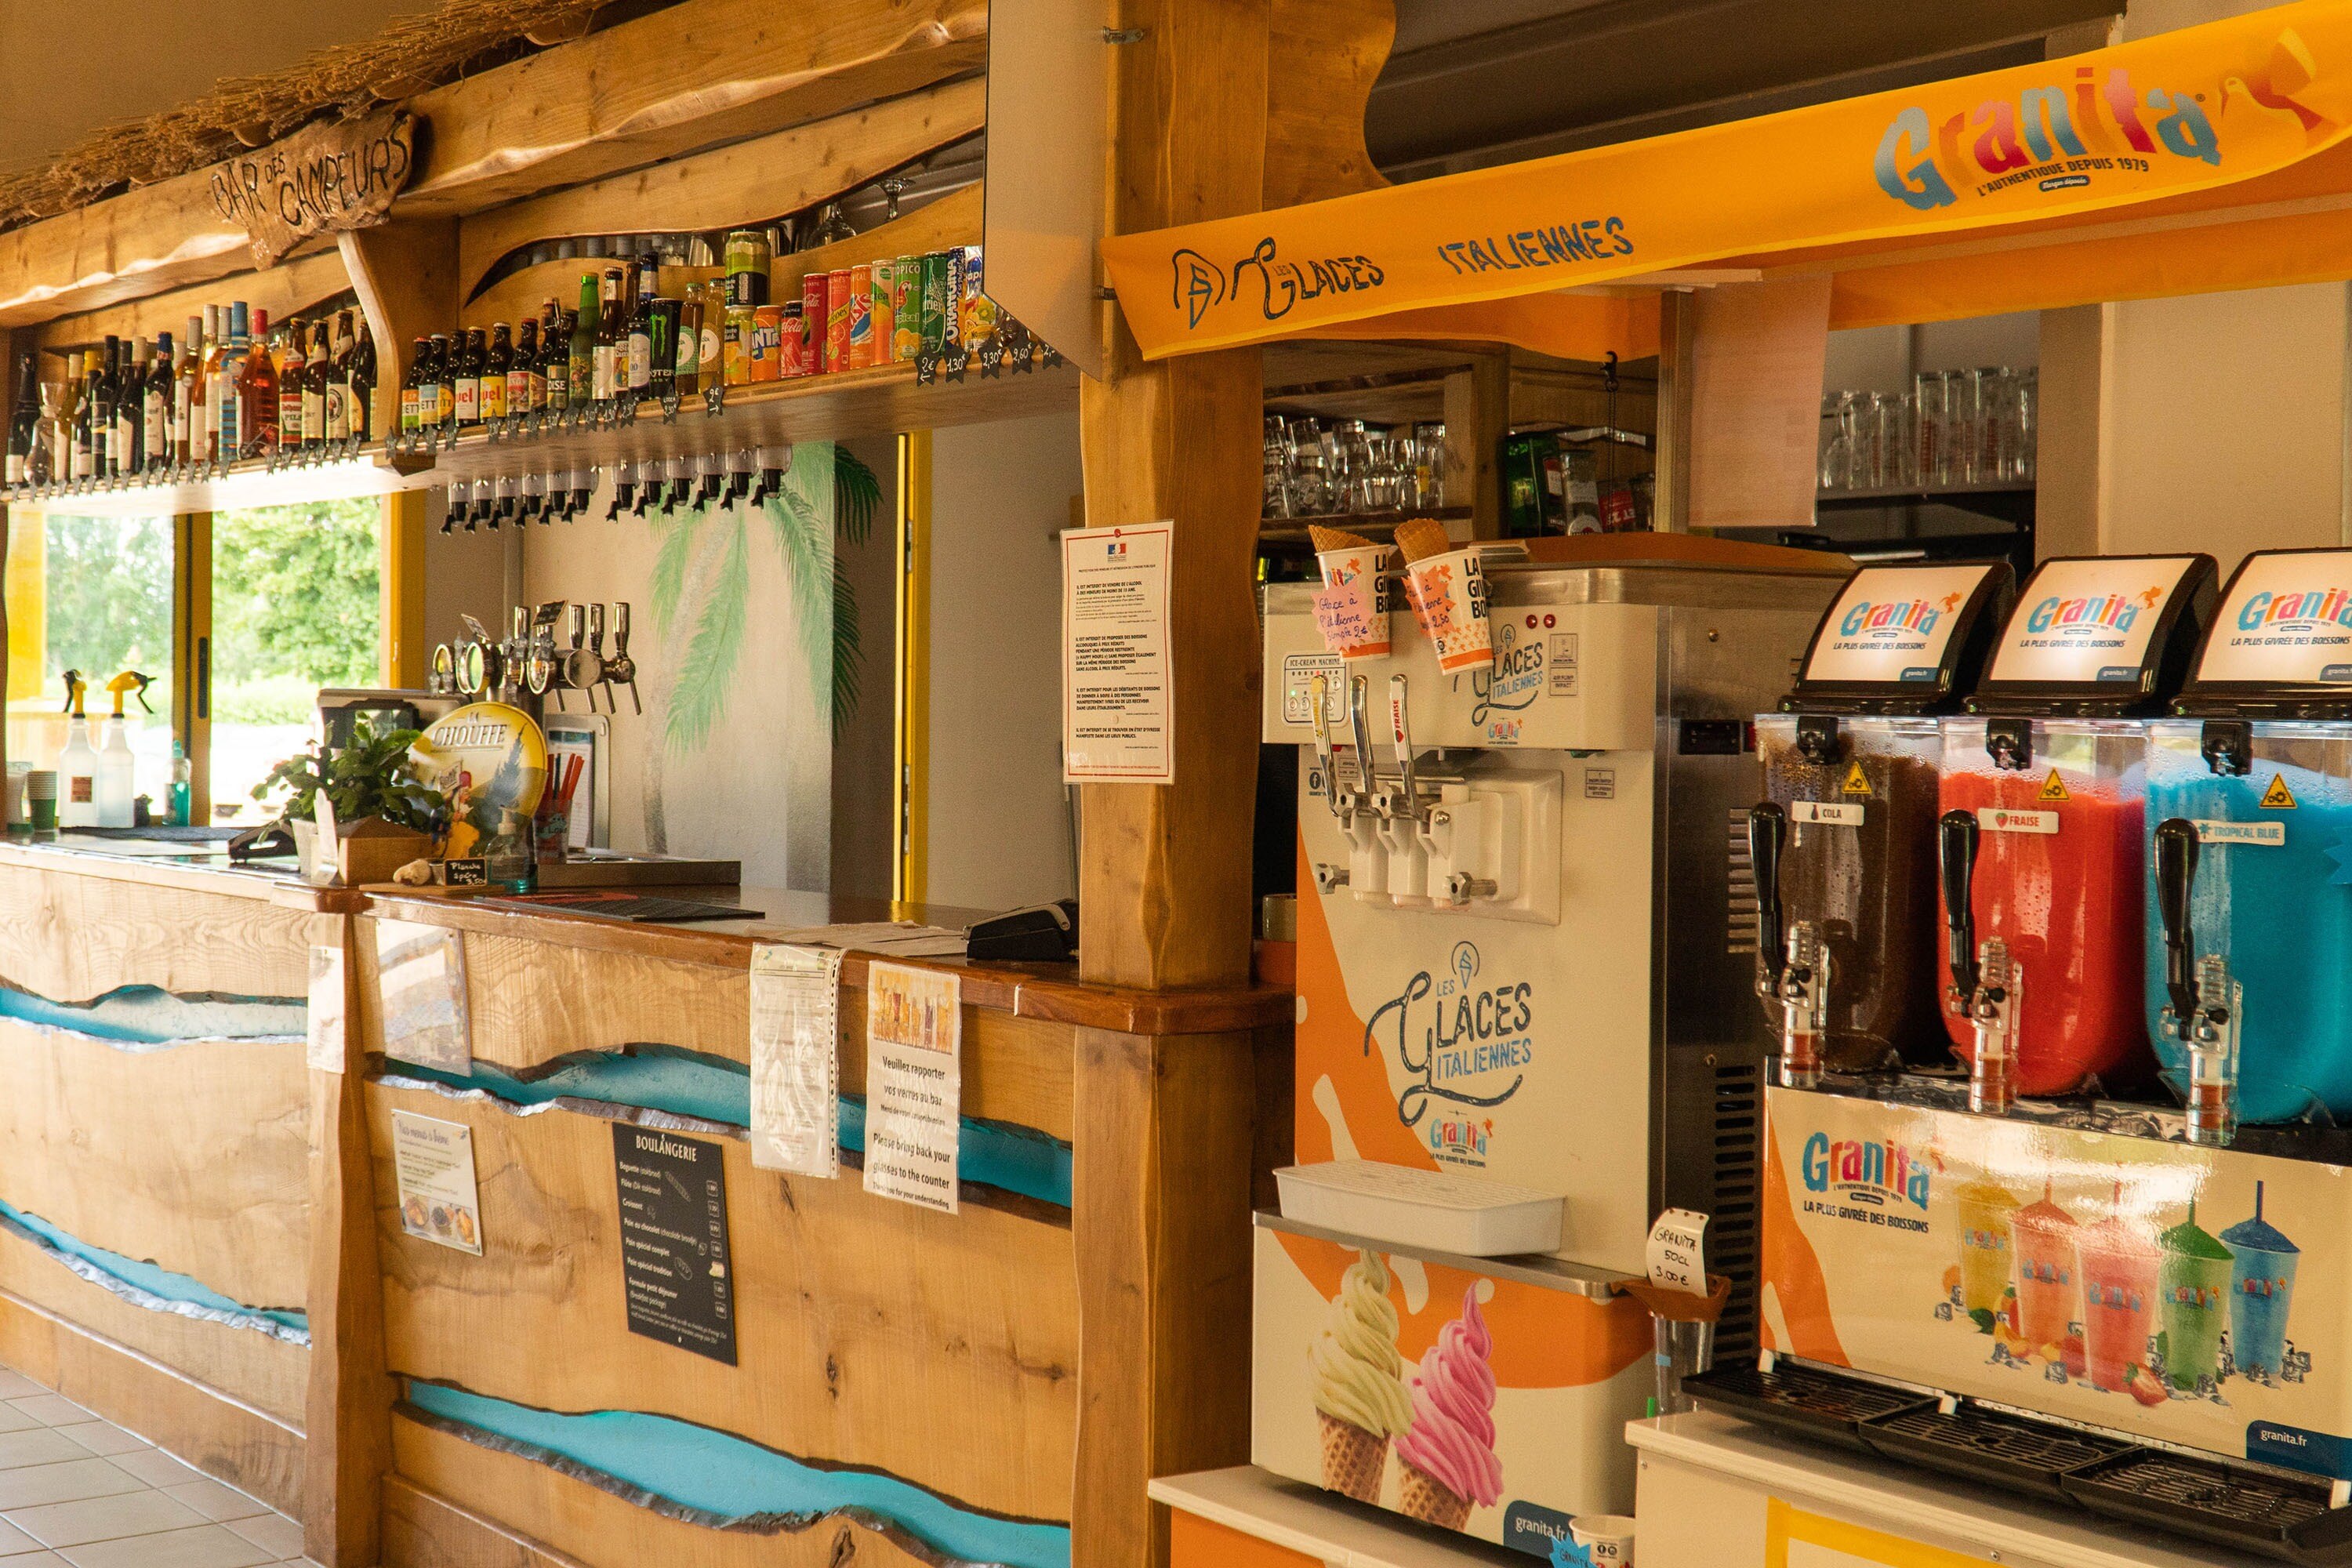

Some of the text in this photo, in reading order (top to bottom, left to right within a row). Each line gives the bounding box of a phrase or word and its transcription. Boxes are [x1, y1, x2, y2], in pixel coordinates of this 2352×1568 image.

[1875, 67, 2222, 211] Granita
[212, 132, 407, 226] BAR DES CAMPEURS
[1976, 157, 2150, 197] L'AUTHENTIQUE DEPUIS 1979
[895, 264, 920, 274] OPICO
[1235, 216, 1634, 320] GLACES ITALIENNES
[946, 258, 960, 340] ORANGINA
[753, 328, 781, 348] NTA
[1319, 593, 1358, 611] Glace à
[2027, 593, 2139, 633] Granita
[1840, 599, 1940, 637] Granita
[2264, 636, 2293, 645] GIVRÉE
[2295, 637, 2310, 645] DES
[2311, 636, 2351, 644] BOISSONS
[1493, 670, 1544, 699] ITALIENNES
[1393, 699, 1402, 728] FRAISE
[432, 723, 508, 747] CHOUFFE
[1822, 808, 1842, 820] COLA
[2009, 815, 2040, 827] FRAISE
[2213, 826, 2280, 839] TROPICAL BLUE
[1436, 980, 1455, 996] LES
[883, 1055, 946, 1080] Veuillez rapporter
[1437, 1038, 1532, 1080] ITALIENNES
[884, 1085, 942, 1106] vos verres au bar
[636, 1135, 697, 1162] BOULANGERIE
[873, 1133, 950, 1163] Please bring back your
[1430, 1118, 1486, 1156] Granita
[873, 1161, 950, 1189] glasses to the counter
[1802, 1131, 1930, 1211] Granita
[903, 1190, 914, 1200] your
[914, 1192, 949, 1210] understanding
[1804, 1200, 1929, 1234] LA PLUS GIVRÉE DES BOISSONS
[1654, 1226, 1697, 1251] GRANITA
[1664, 1250, 1690, 1266] 50CL
[2260, 1428, 2307, 1448] granita.fr
[1515, 1516, 1566, 1540] granita.fr
